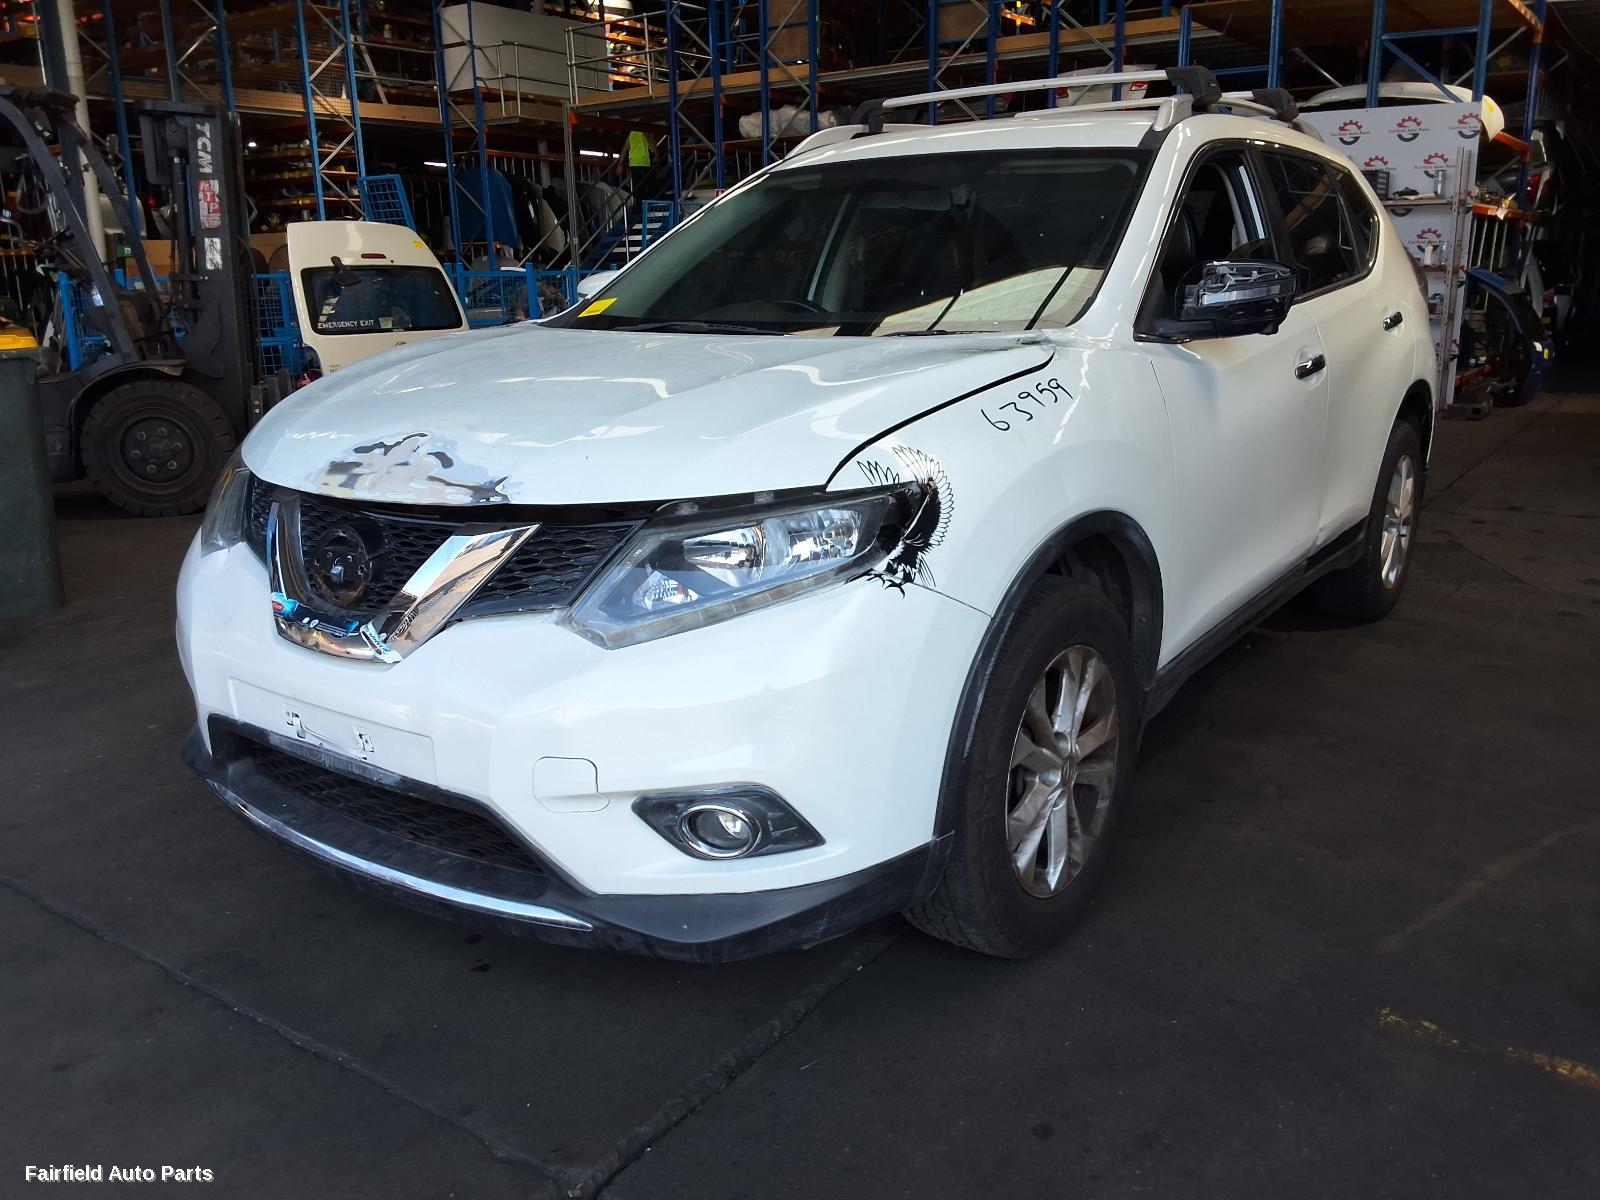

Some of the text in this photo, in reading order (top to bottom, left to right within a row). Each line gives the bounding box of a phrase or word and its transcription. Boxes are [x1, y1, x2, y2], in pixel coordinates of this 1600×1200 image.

[195, 122, 213, 174] TCM
[317, 319, 374, 329] EMERGENCY EXIT
[981, 378, 1073, 431] 63959
